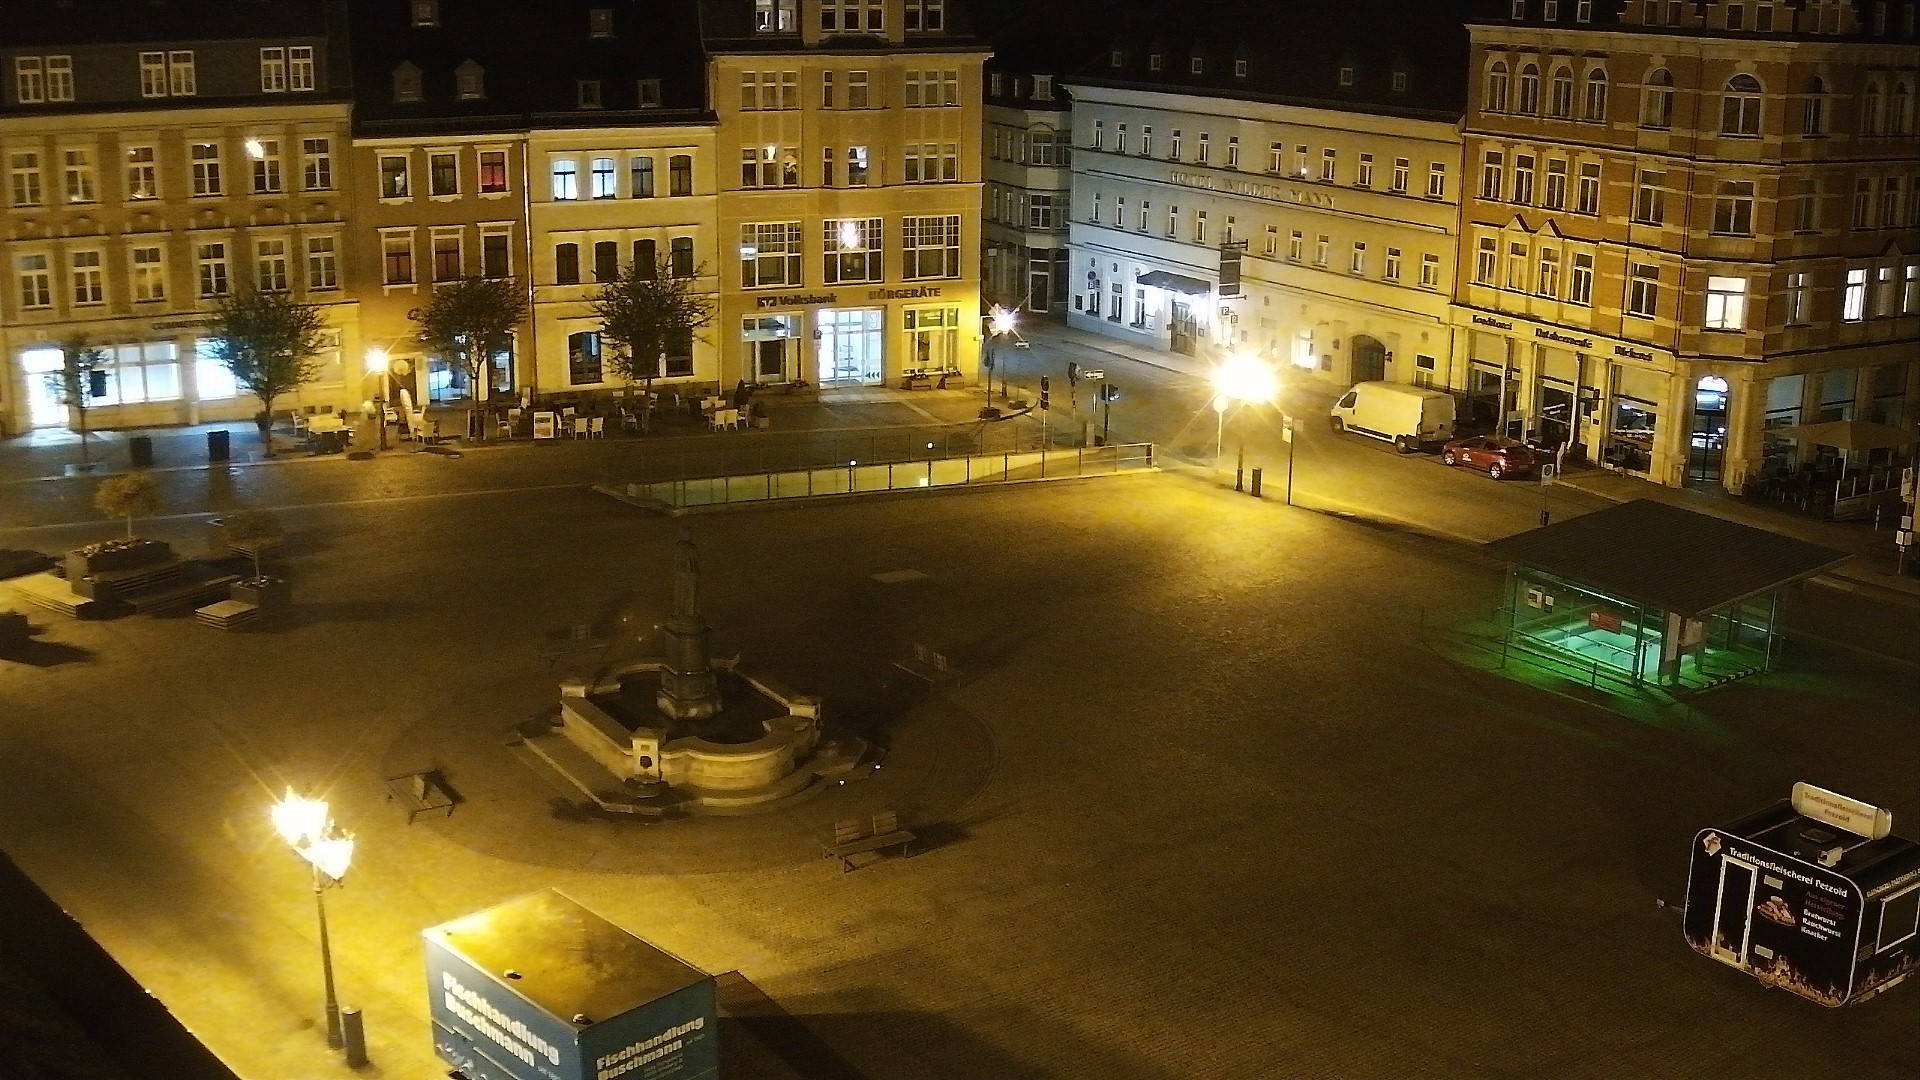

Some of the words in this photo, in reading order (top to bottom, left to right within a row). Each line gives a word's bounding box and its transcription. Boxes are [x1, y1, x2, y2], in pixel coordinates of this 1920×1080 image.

[1170, 170, 1215, 190] HOTEL
[1223, 178, 1281, 201] WILDER
[1290, 188, 1336, 208] MANN
[779, 293, 837, 306] Volksbank
[868, 286, 941, 300] HÖRGERÄTE
[1803, 791, 1873, 821] Traditionsfleischerei
[1729, 846, 1814, 886] Traditionsfleischerei
[1815, 878, 1848, 898] Petzold
[1802, 917, 1842, 938] Rauchwurst
[1803, 907, 1837, 927] Bratwurst
[442, 970, 560, 1066] Fischhandlung
[444, 990, 535, 1068] Buschmann
[596, 1016, 705, 1070] Fischhandlung
[597, 1038, 683, 1080] Buschmann
